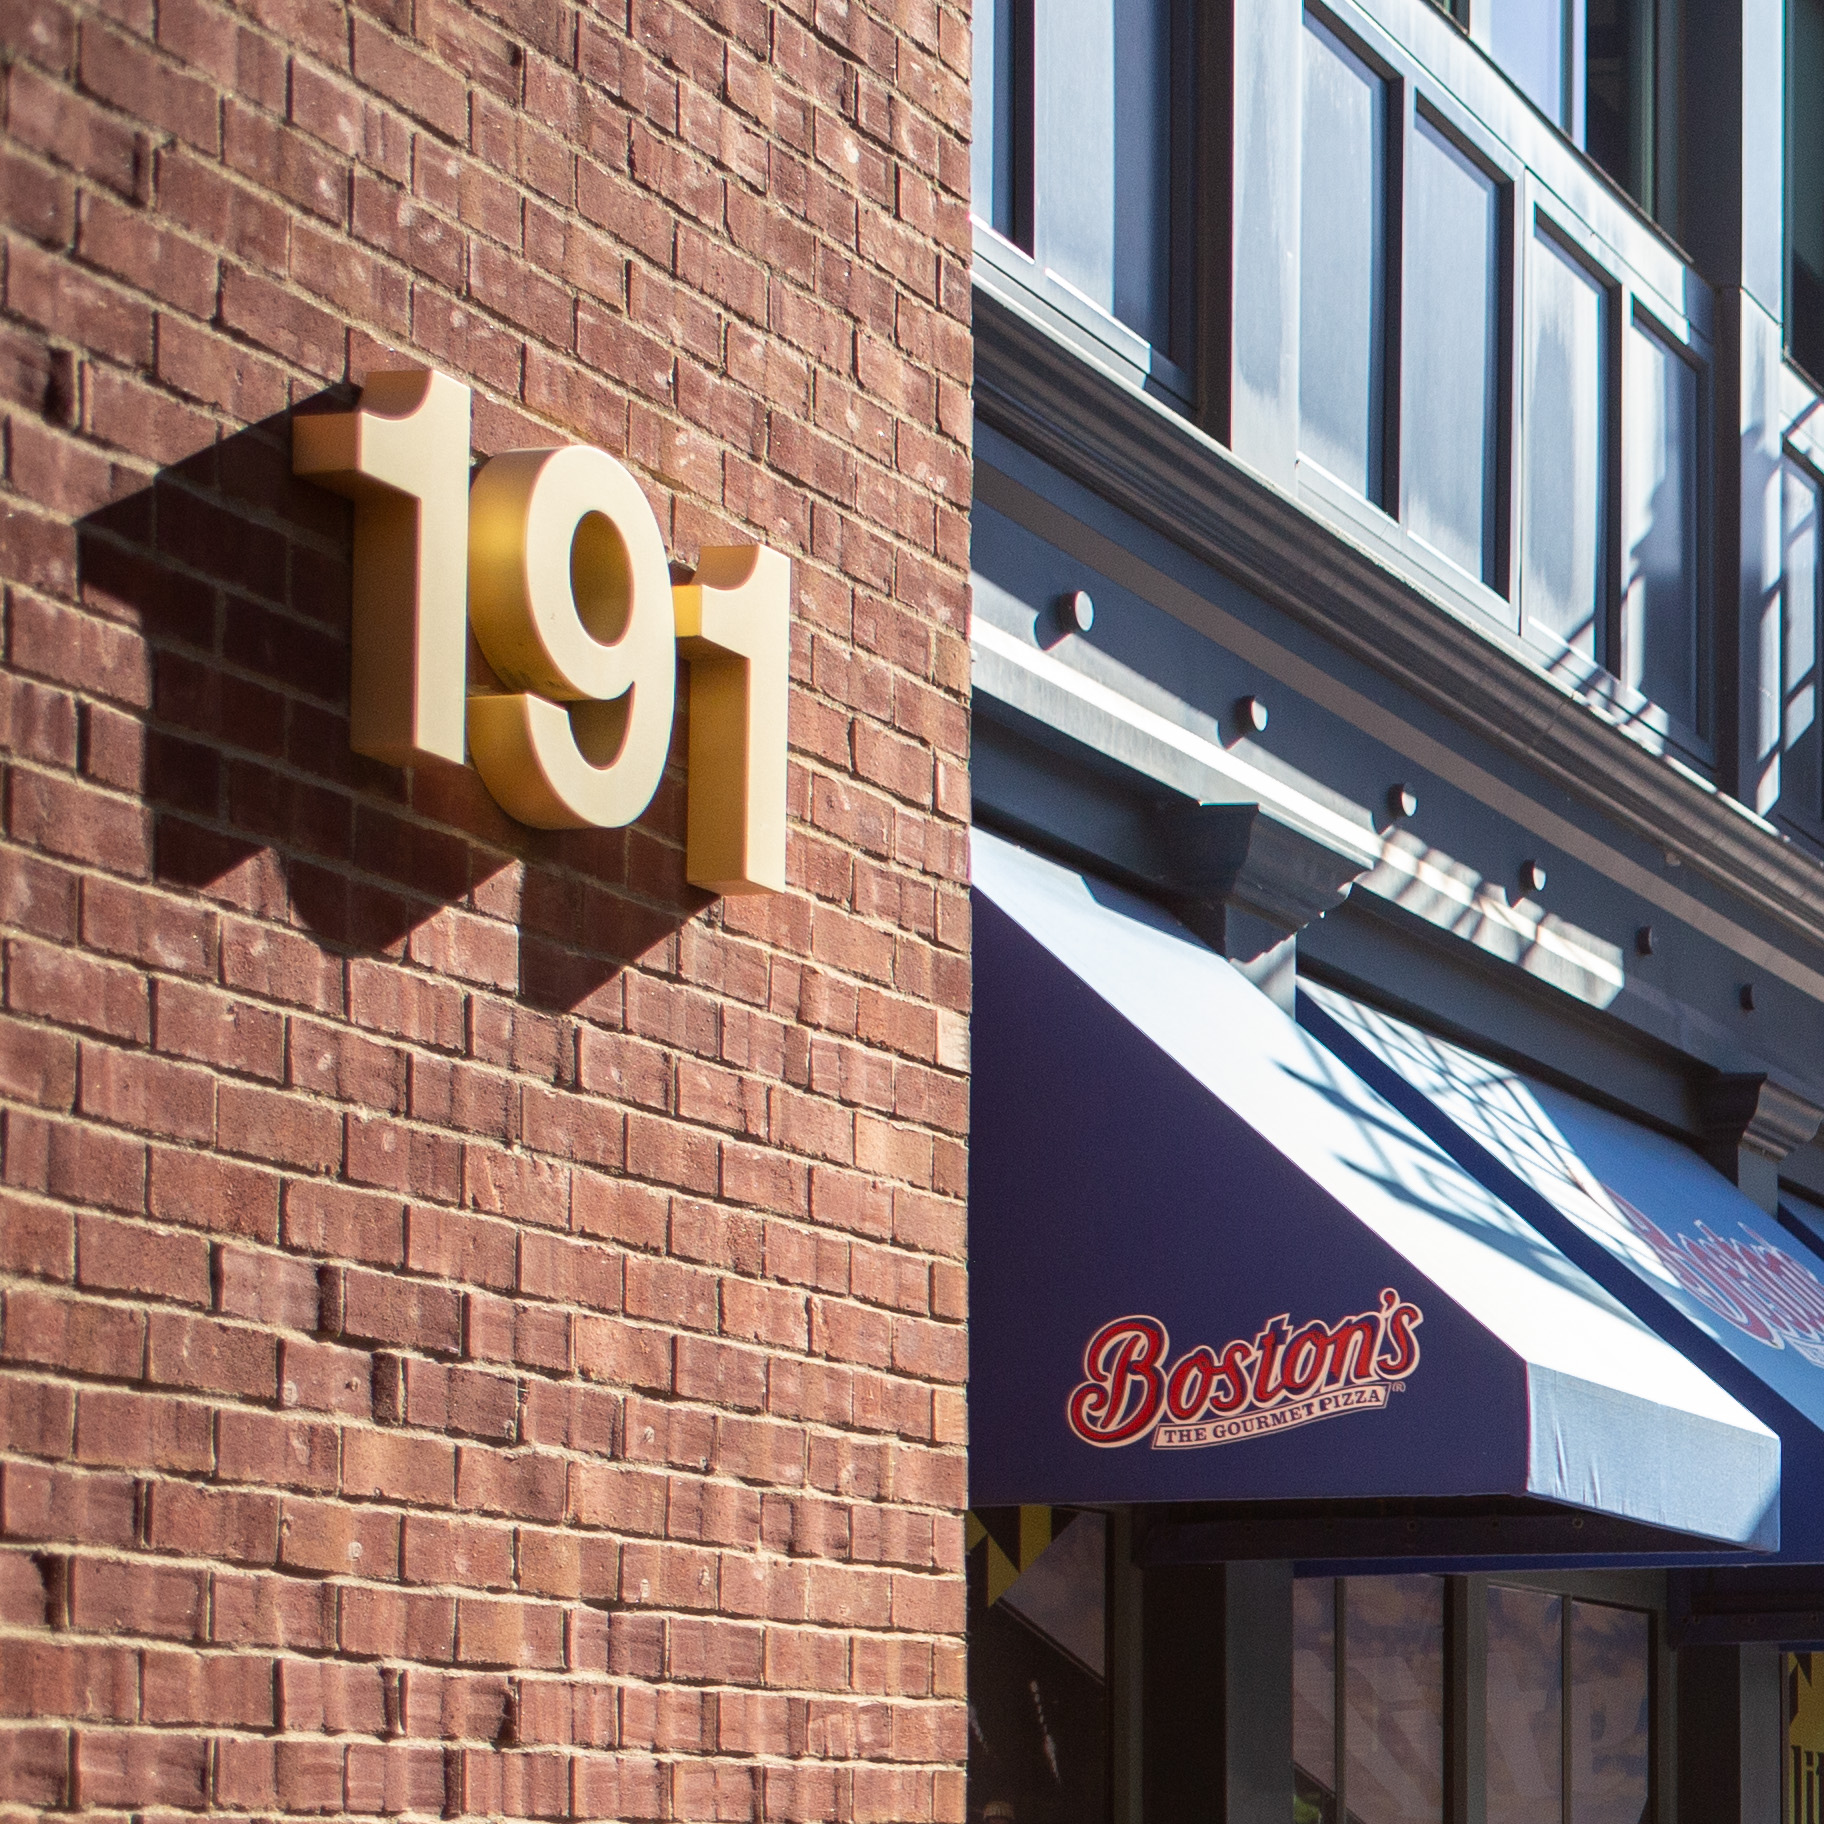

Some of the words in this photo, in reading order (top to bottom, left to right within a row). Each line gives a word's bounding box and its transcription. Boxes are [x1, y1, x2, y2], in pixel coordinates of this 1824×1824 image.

[293, 369, 790, 896] 191
[1067, 1287, 1424, 1449] Boston's
[1165, 1426, 1209, 1445] THE
[1212, 1402, 1315, 1441] GOURMET
[1318, 1387, 1382, 1412] PIZZA
